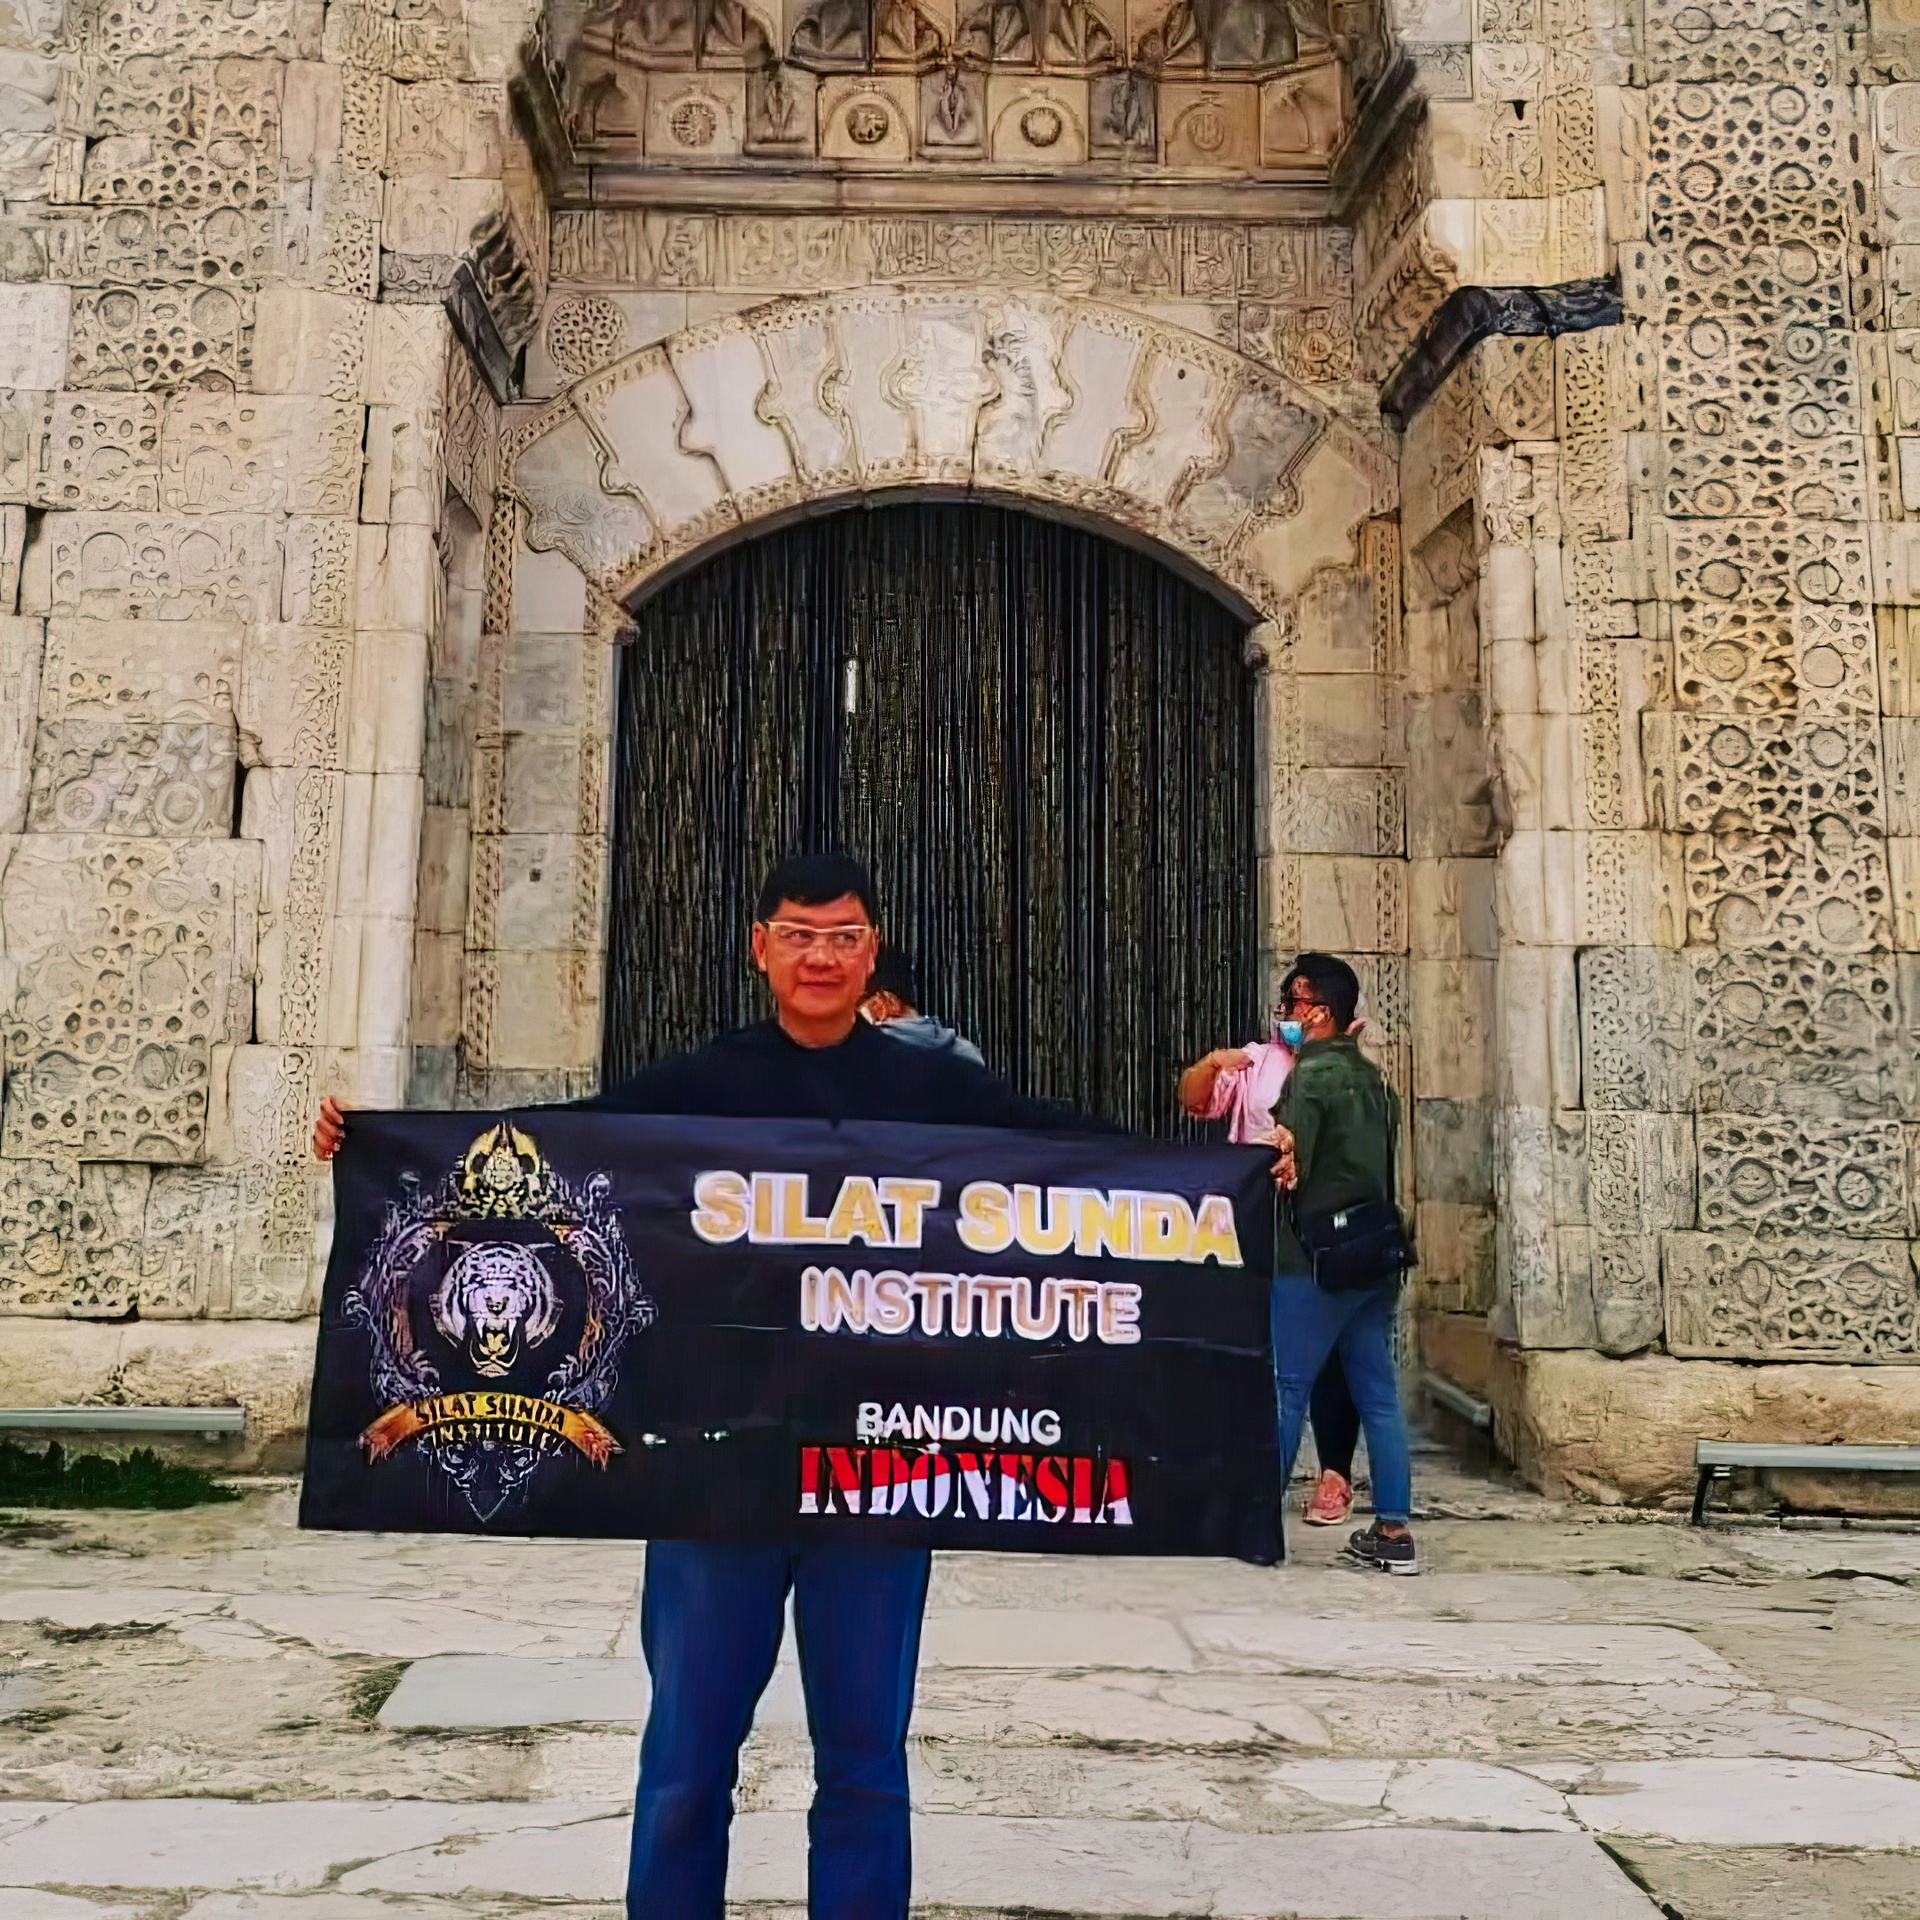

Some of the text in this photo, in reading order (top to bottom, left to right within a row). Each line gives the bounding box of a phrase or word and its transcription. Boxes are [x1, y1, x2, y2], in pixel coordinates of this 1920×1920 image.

[690, 1170, 1244, 1268] SILAT SUNDA
[800, 1266, 1142, 1344] INSTITUTE
[414, 1393, 566, 1432] SILAT SUNDA
[856, 1402, 1062, 1446] BANDUNG
[799, 1447, 1133, 1525] INDONESIA
